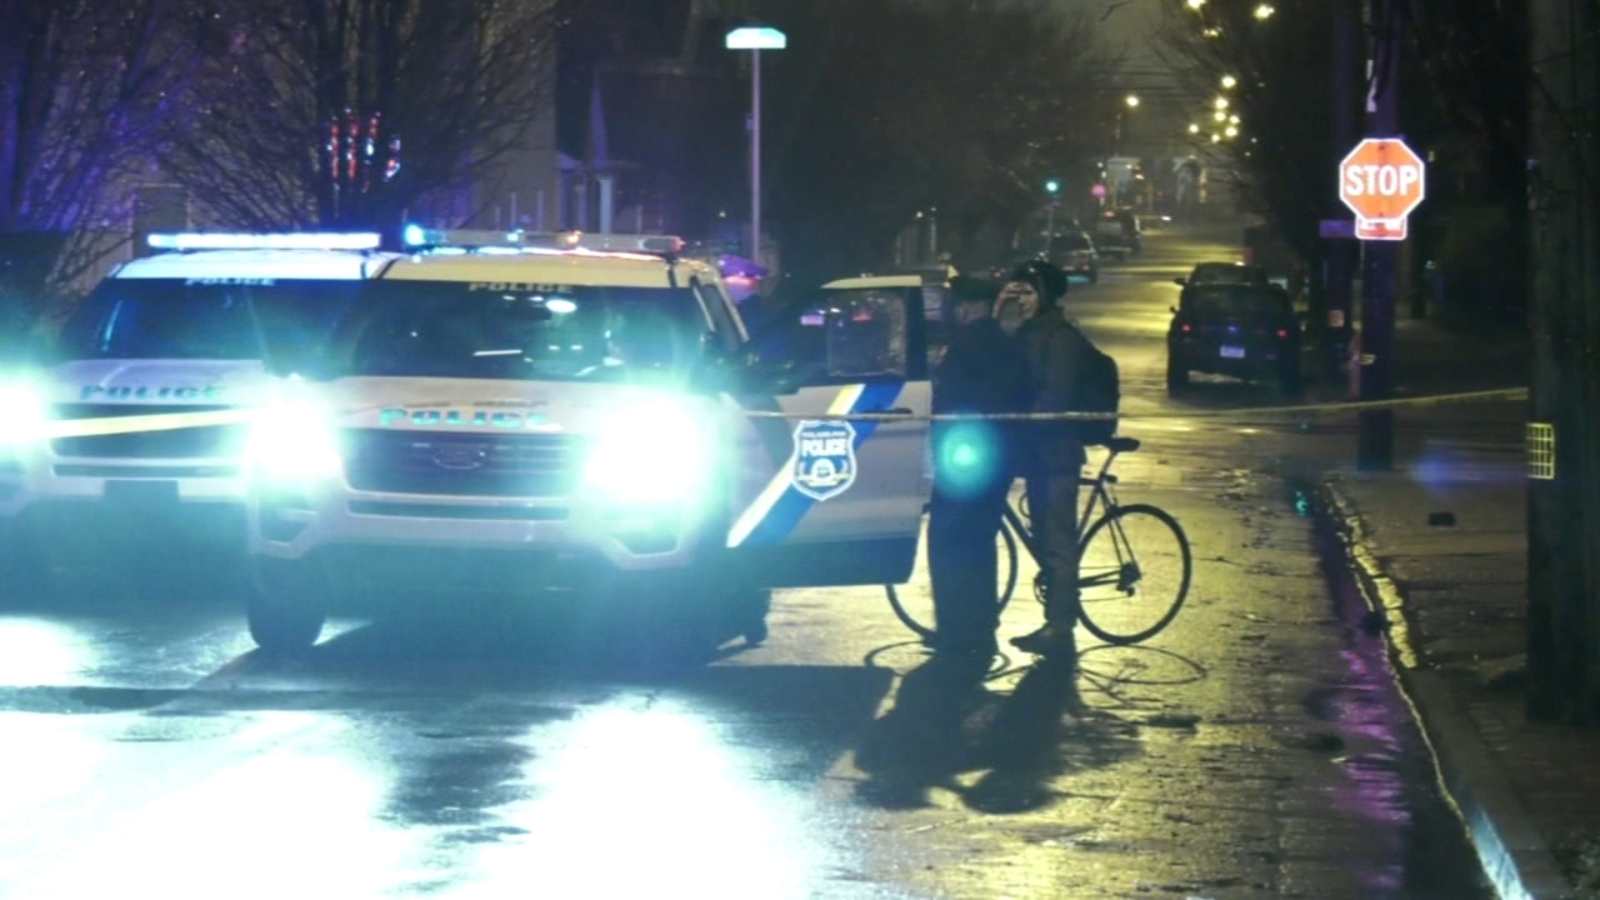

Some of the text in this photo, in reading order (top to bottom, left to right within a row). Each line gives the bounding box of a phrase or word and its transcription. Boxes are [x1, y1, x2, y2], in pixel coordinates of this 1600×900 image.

[1345, 164, 1418, 196] STOP
[184, 276, 276, 287] POLICE
[468, 281, 574, 294] POLICE
[80, 384, 228, 402] POLICE
[379, 406, 556, 430] POLICE
[801, 438, 847, 457] POLICE
